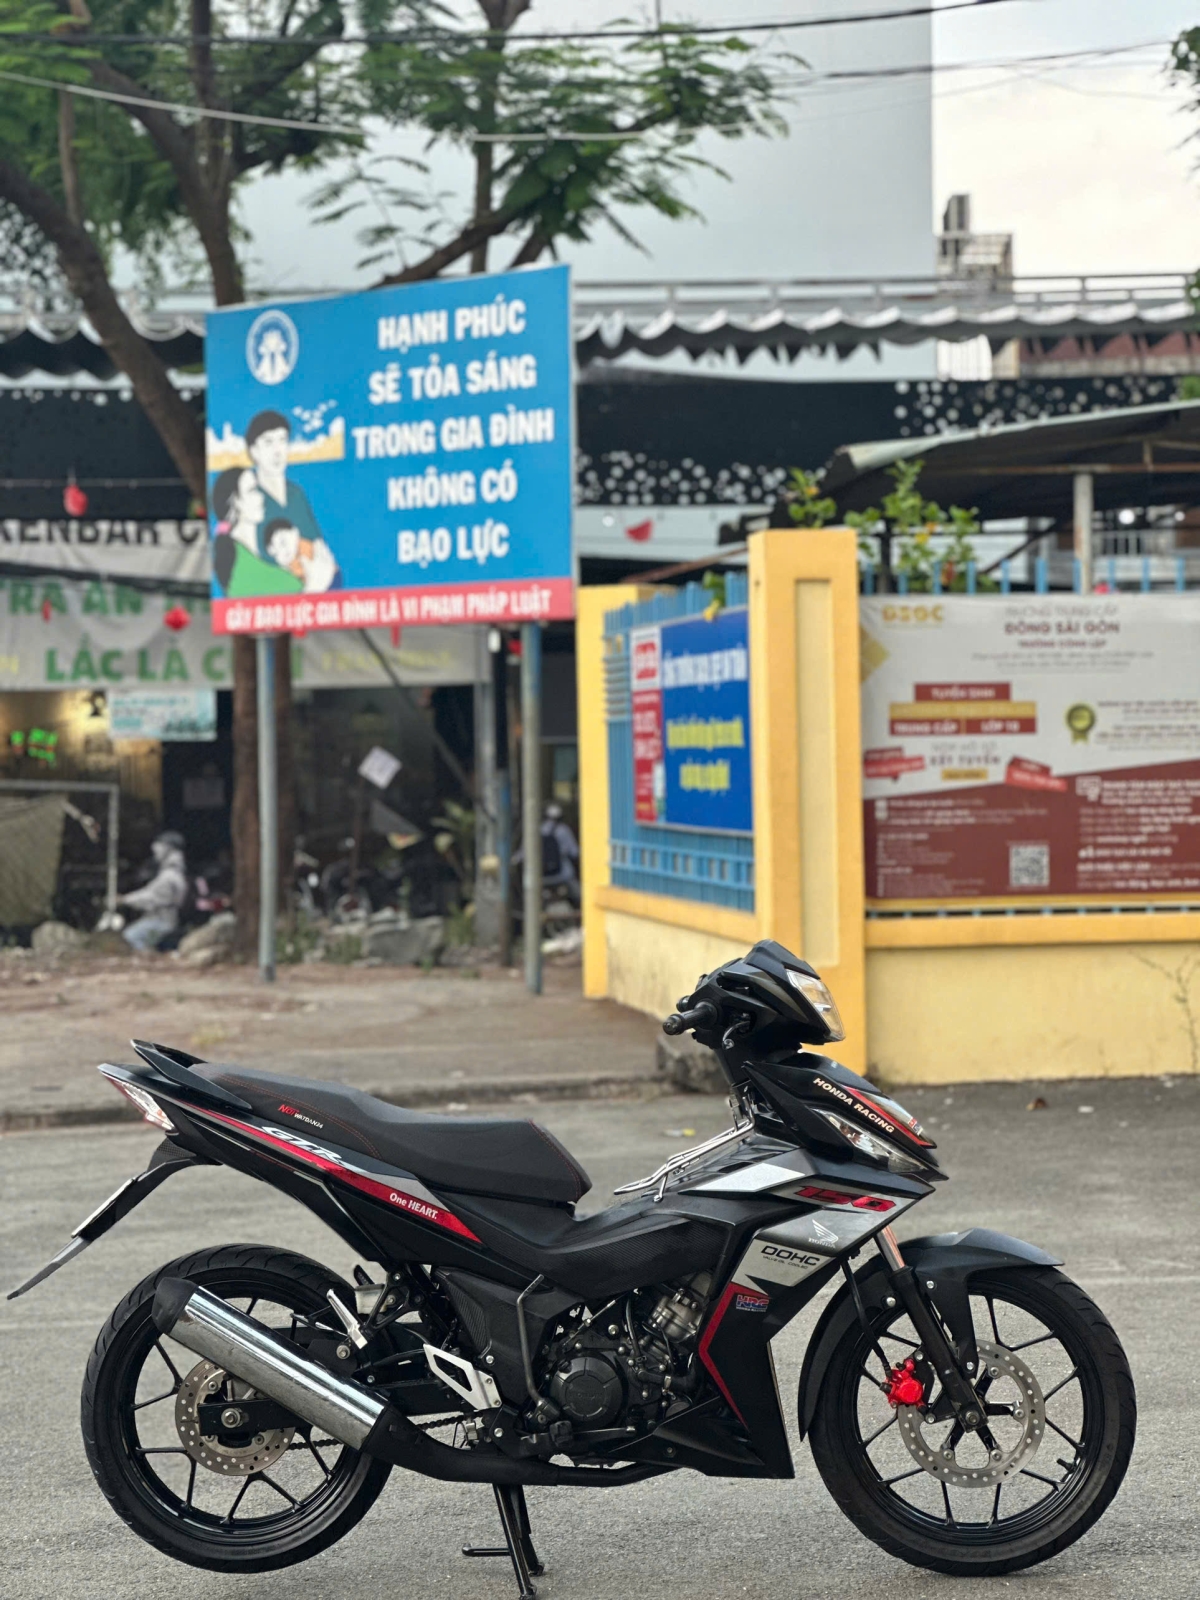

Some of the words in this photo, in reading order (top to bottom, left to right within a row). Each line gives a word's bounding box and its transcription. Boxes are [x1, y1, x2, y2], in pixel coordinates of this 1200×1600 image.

[378, 309, 449, 354] HẠNH
[455, 293, 527, 342] PHÚC
[368, 362, 402, 405] SẼ
[408, 353, 461, 400] TỎA
[466, 350, 538, 395] SÁNG
[352, 420, 437, 460] TRONG
[440, 415, 485, 452] GIA
[489, 404, 555, 446] ĐÌNH
[387, 465, 476, 511] KHÔNG
[480, 458, 518, 503] CÓ
[397, 527, 452, 569] BẠO
[456, 518, 510, 566] LỰC
[253, 604, 284, 632] BẠO
[285, 599, 315, 629] LỰC
[379, 592, 400, 623] LÀ
[419, 593, 466, 623] PHẠM
[466, 585, 509, 617] PHÁP
[510, 583, 553, 619] LUẬT
[813, 1077, 854, 1106] HONDA
[854, 1103, 895, 1134] RACING
[262, 1126, 342, 1165] GTR
[389, 1192, 408, 1207] One
[407, 1199, 439, 1220] HEART.
[794, 1185, 897, 1213] 150
[761, 1245, 820, 1267] DOHC
[808, 1236, 836, 1249] HONDA
[735, 1294, 770, 1310] HRC
